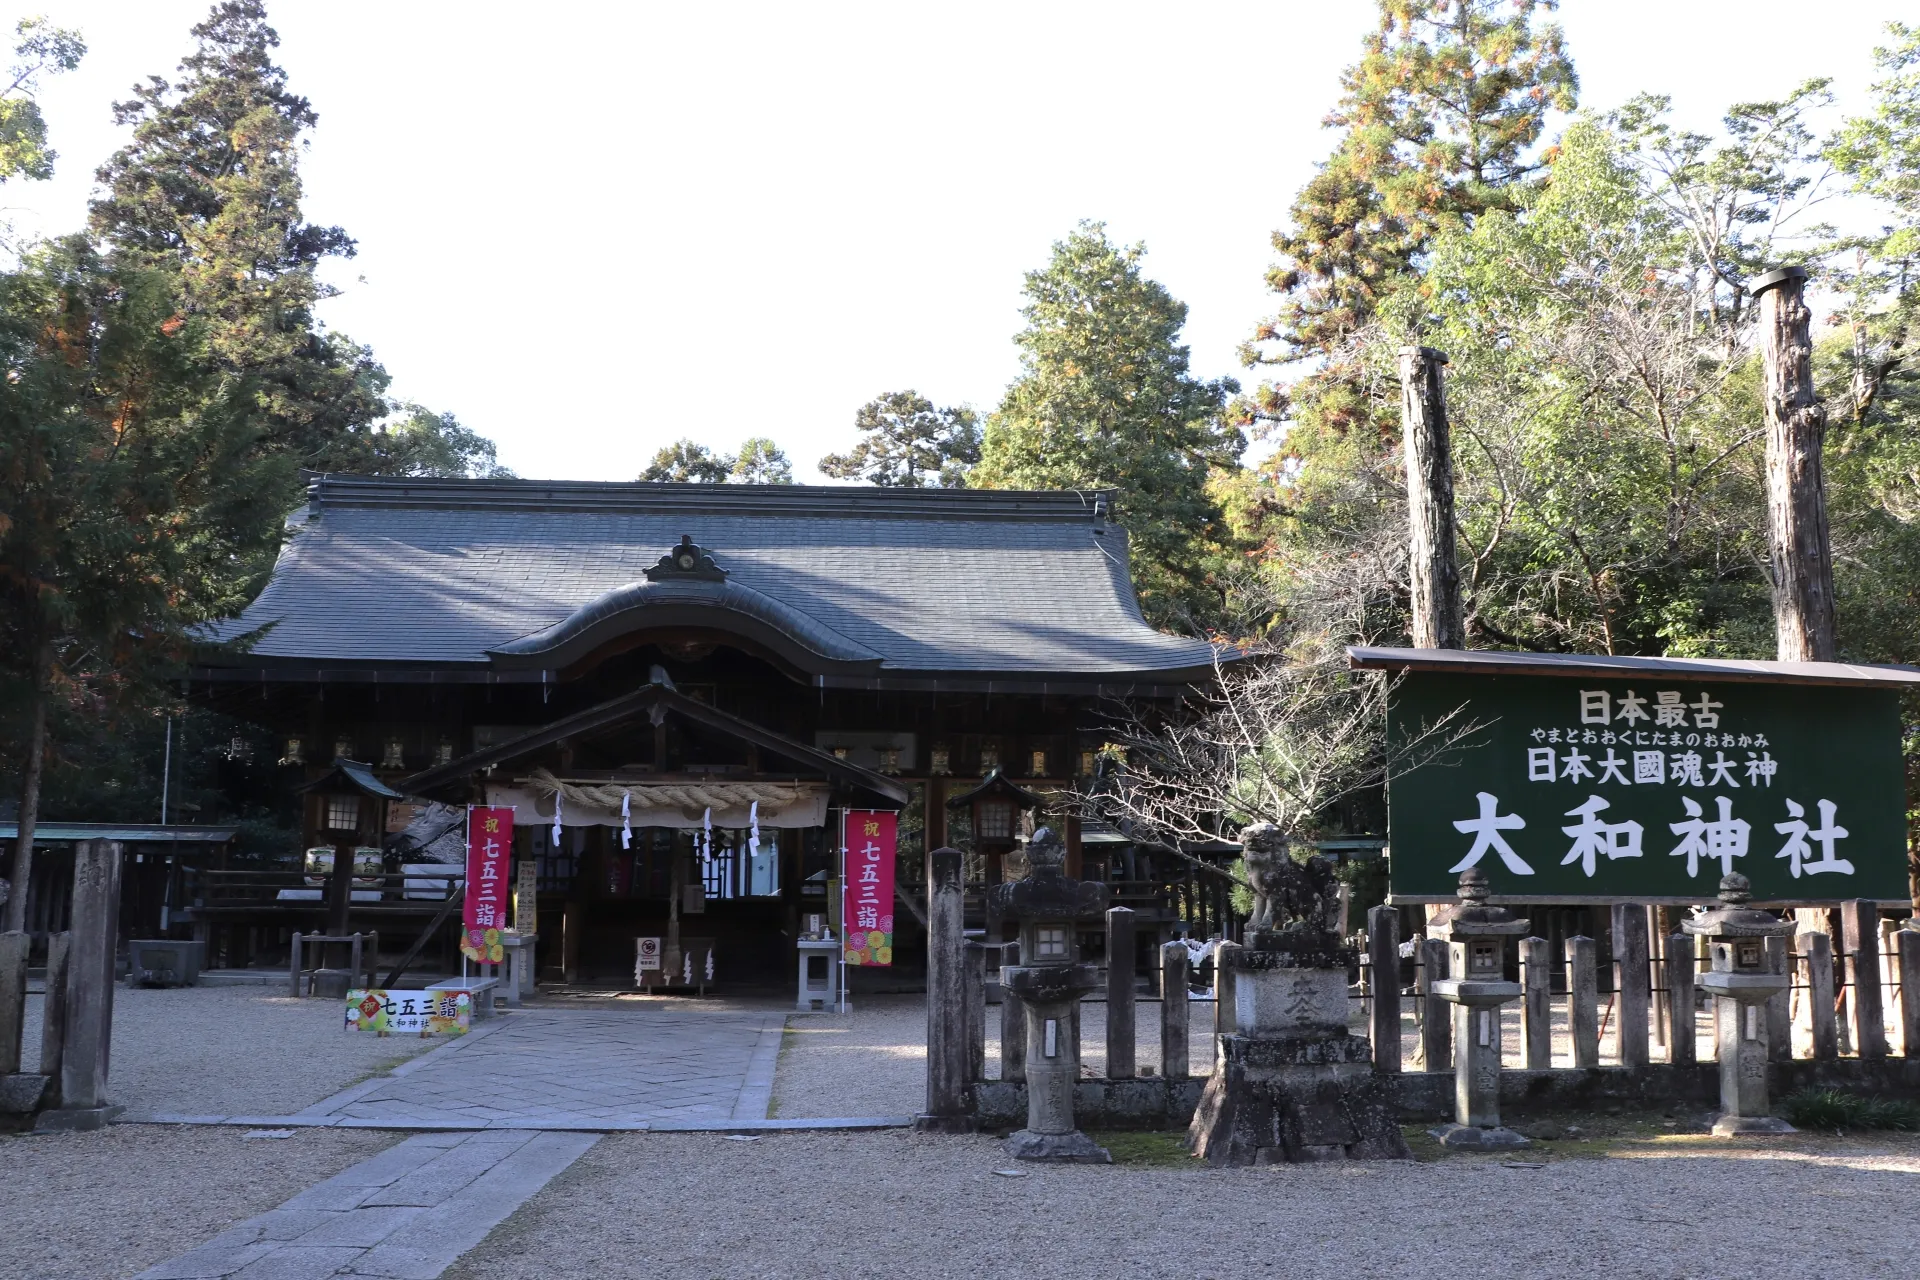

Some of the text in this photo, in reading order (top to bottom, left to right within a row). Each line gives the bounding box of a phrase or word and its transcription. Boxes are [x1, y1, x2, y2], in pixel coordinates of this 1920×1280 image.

[1579, 689, 1724, 729] 日本最古
[1530, 728, 1771, 748] やまとおおくにたまのおおかみ
[1528, 746, 1779, 788] 日本大國魂大神
[1449, 792, 1855, 879] 大和神社
[476, 816, 500, 926] 祝 七五三詣
[857, 820, 881, 929] 祝 七五三詣
[362, 997, 458, 1018] 祝 七五三詣
[385, 1018, 430, 1029] 大和神社
